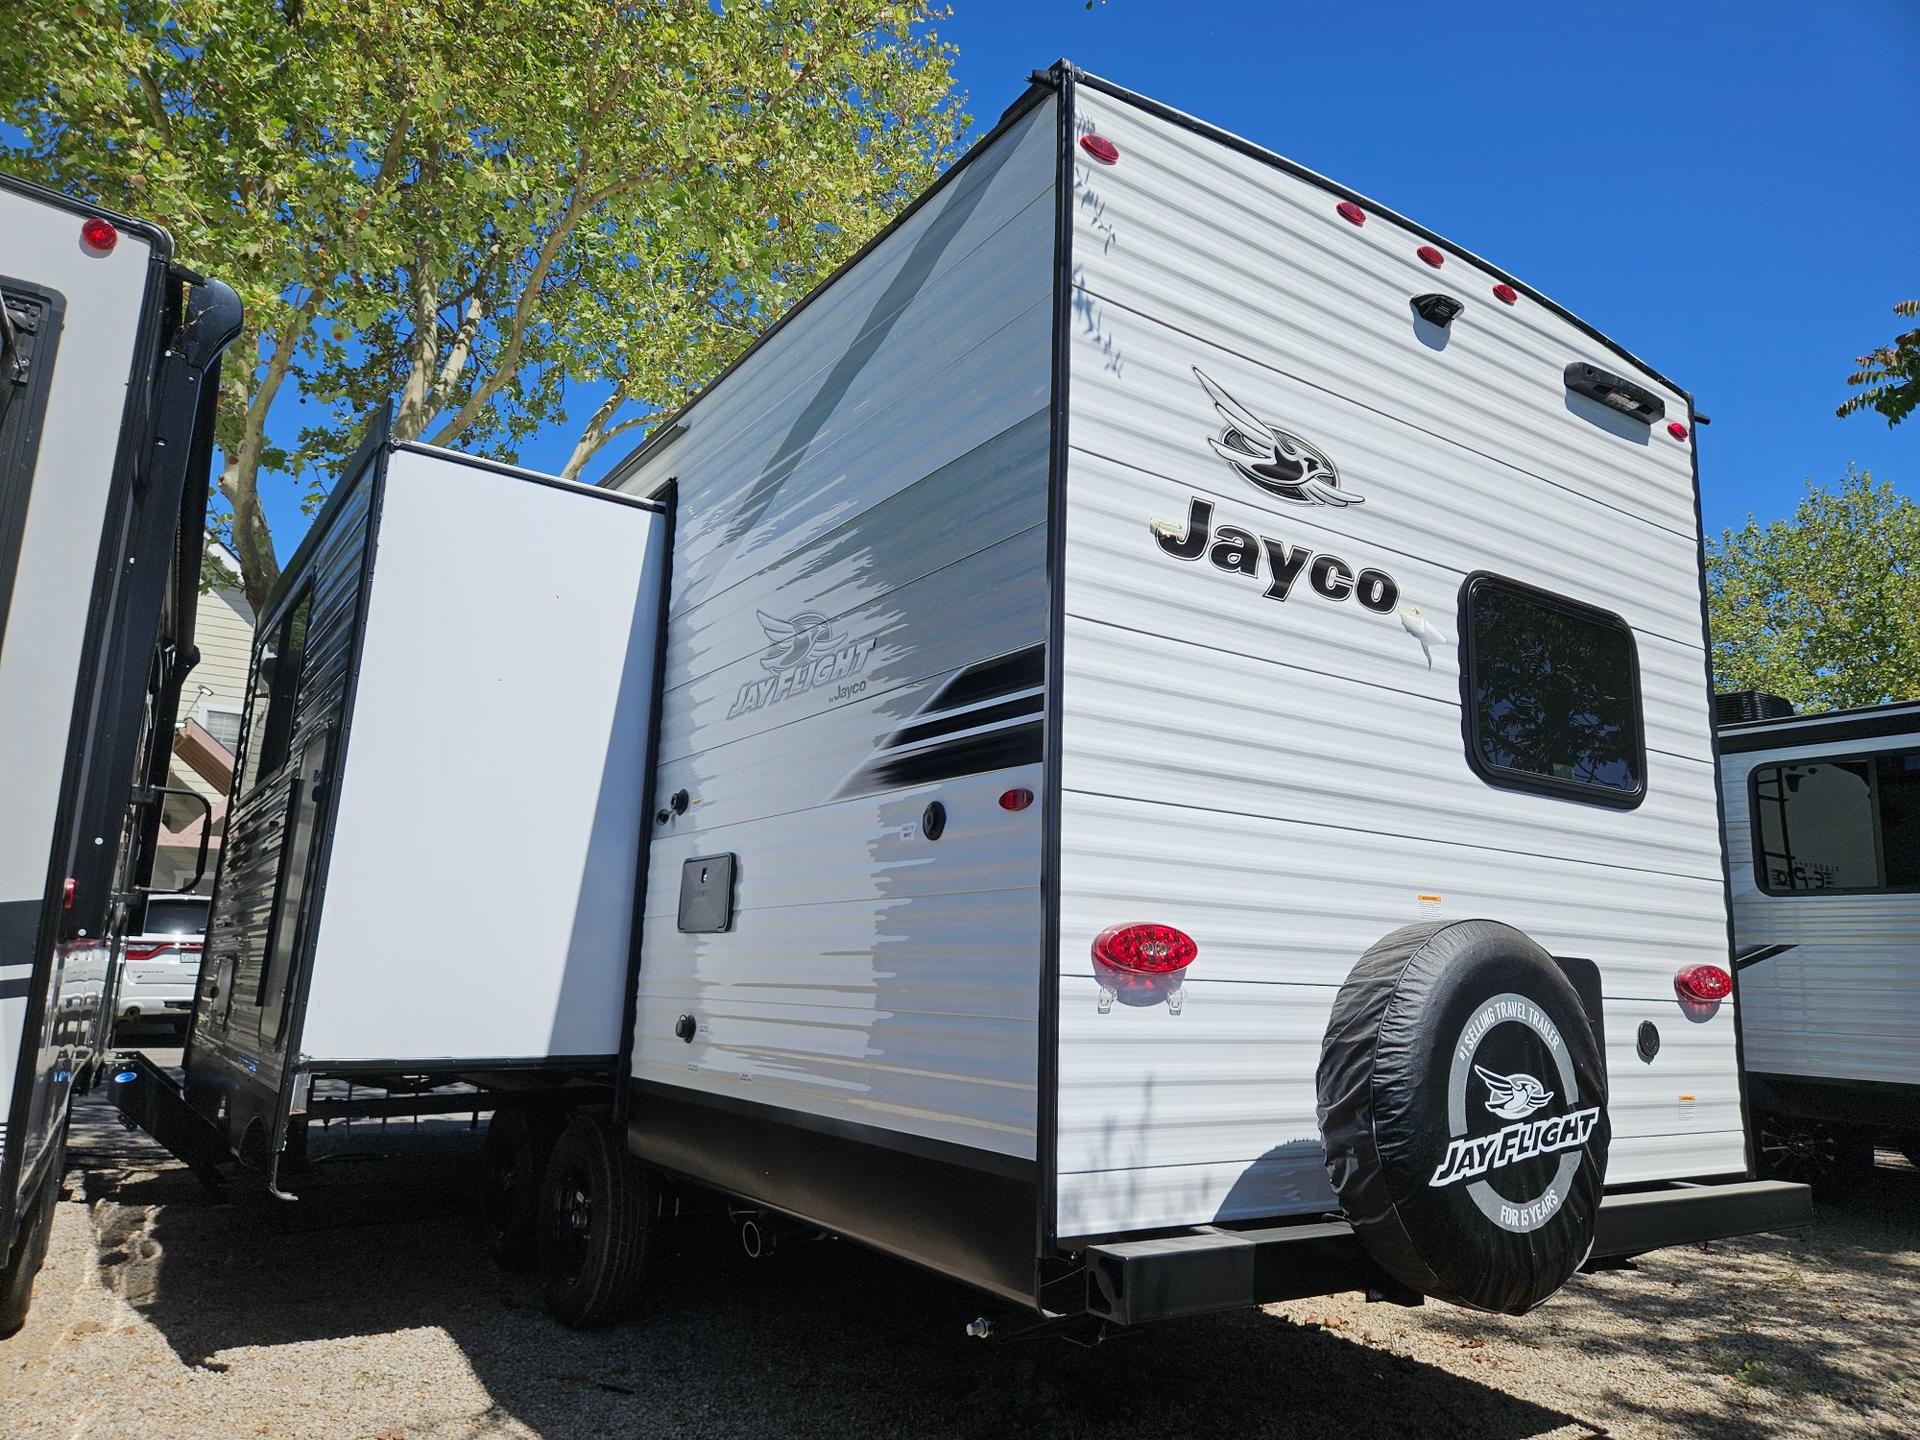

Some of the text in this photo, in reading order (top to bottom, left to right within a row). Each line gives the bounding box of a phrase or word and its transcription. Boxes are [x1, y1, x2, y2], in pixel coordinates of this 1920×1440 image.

[1154, 496, 1401, 614] Jayco
[834, 680, 867, 701] Jayco
[1459, 1001, 1560, 1061] #1 SELLING TRAVEL TRAILER
[1500, 1189, 1558, 1227] FOR 15 YEARS
